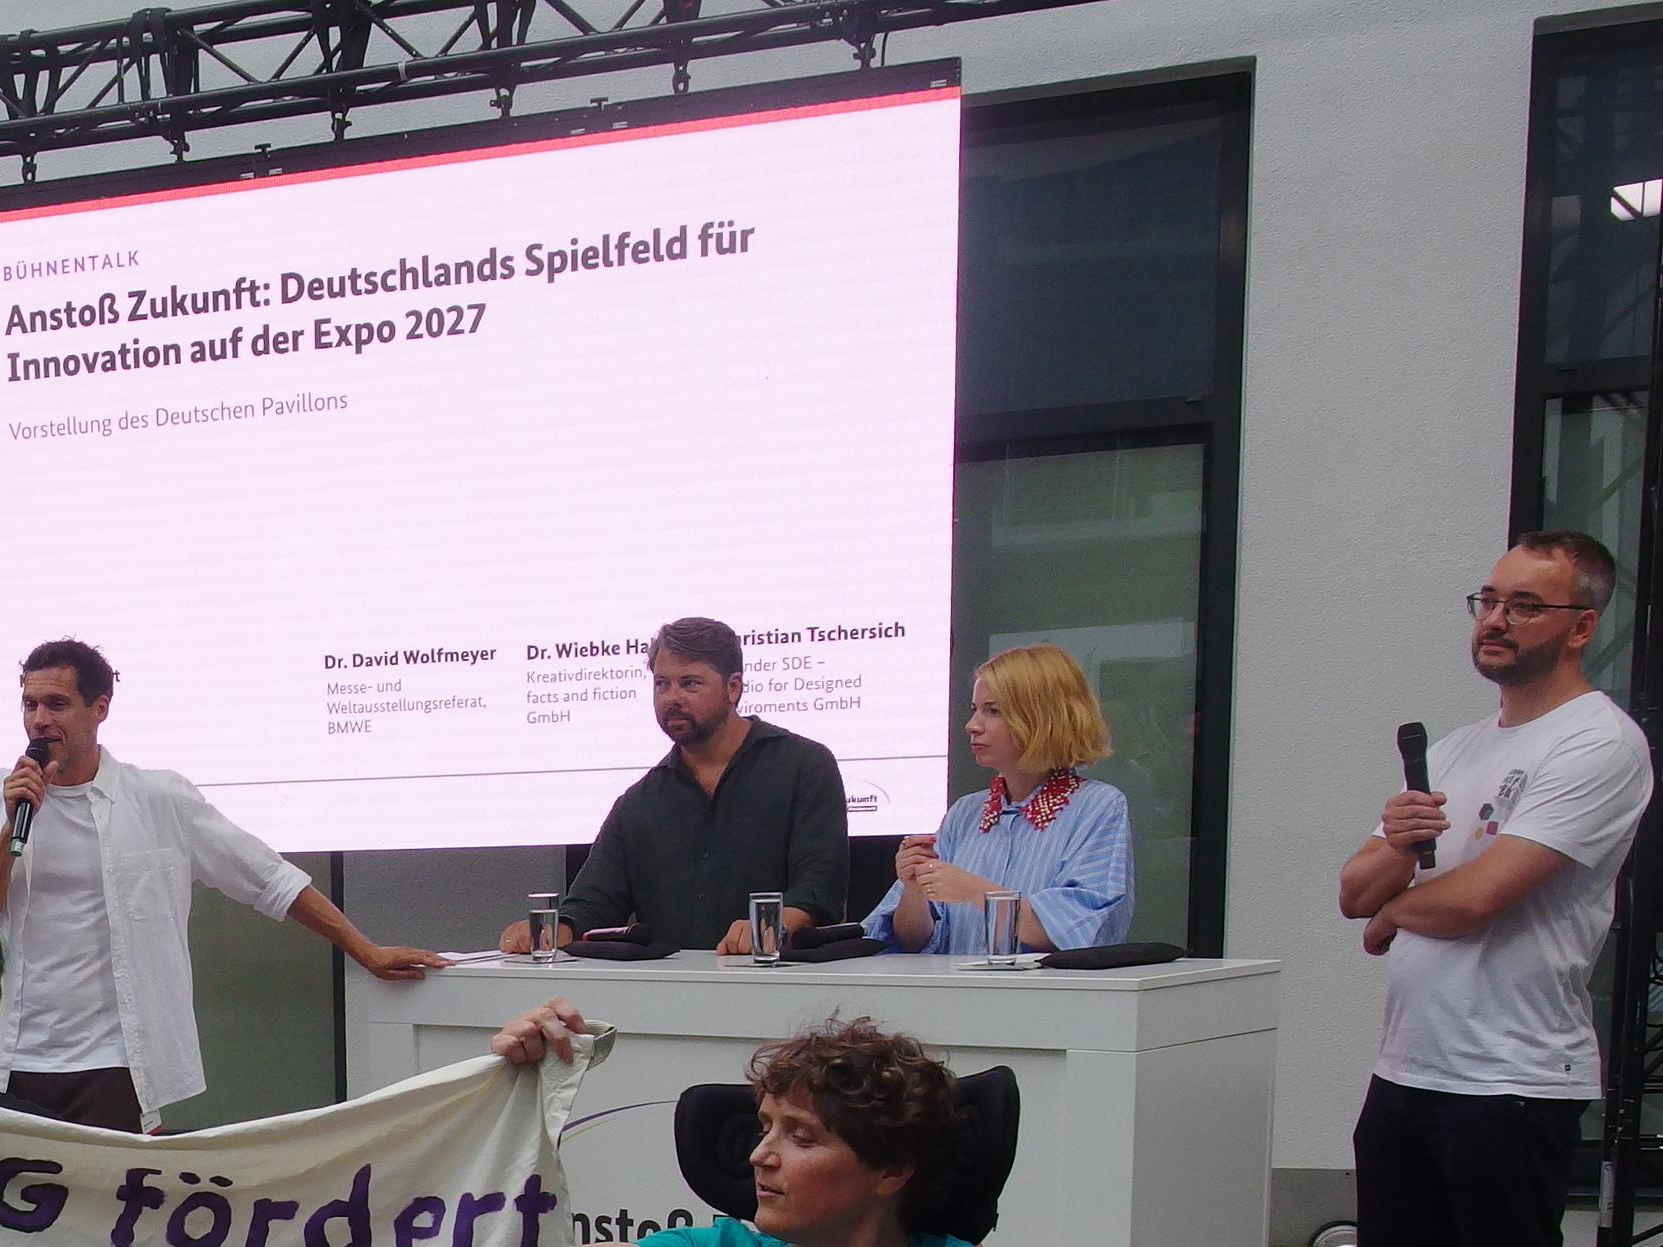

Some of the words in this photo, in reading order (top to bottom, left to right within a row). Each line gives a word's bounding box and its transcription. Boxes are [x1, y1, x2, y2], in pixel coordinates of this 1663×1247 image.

[3, 250, 139, 282] BÜHNENTALK
[5, 292, 120, 336] Anstoß
[127, 277, 270, 322] Zukunft:
[281, 247, 515, 304] Deutschlands
[525, 225, 687, 284] Spielfeld
[697, 220, 755, 258] für
[7, 338, 181, 382] Innovation
[190, 326, 243, 363] auf
[251, 324, 305, 357] der
[314, 318, 396, 355] Expo
[405, 303, 486, 340] 2027
[9, 416, 112, 440] Vorstellung
[118, 410, 149, 430] des
[156, 401, 255, 427] Deutschen
[262, 392, 348, 416] Pavillons
[806, 621, 905, 642] Tschersich
[324, 655, 347, 669] Dr.
[352, 650, 398, 668] David
[403, 648, 497, 666] Wolfmeyer
[527, 645, 551, 660] Dr.
[555, 640, 620, 659] Wiebke
[782, 655, 812, 671] SDE
[527, 665, 646, 683] Kreativdirektorin,
[768, 678, 789, 692] for
[794, 674, 862, 693] Designed
[327, 682, 373, 696] Messe-
[377, 678, 402, 693] und
[526, 690, 559, 704] facts
[563, 688, 588, 702] and
[593, 686, 637, 701] fiction
[326, 695, 486, 715] Weltausstellungsreferat,
[813, 696, 861, 711] GmbH
[526, 709, 570, 724] GmbH
[328, 719, 372, 735] BMWE
